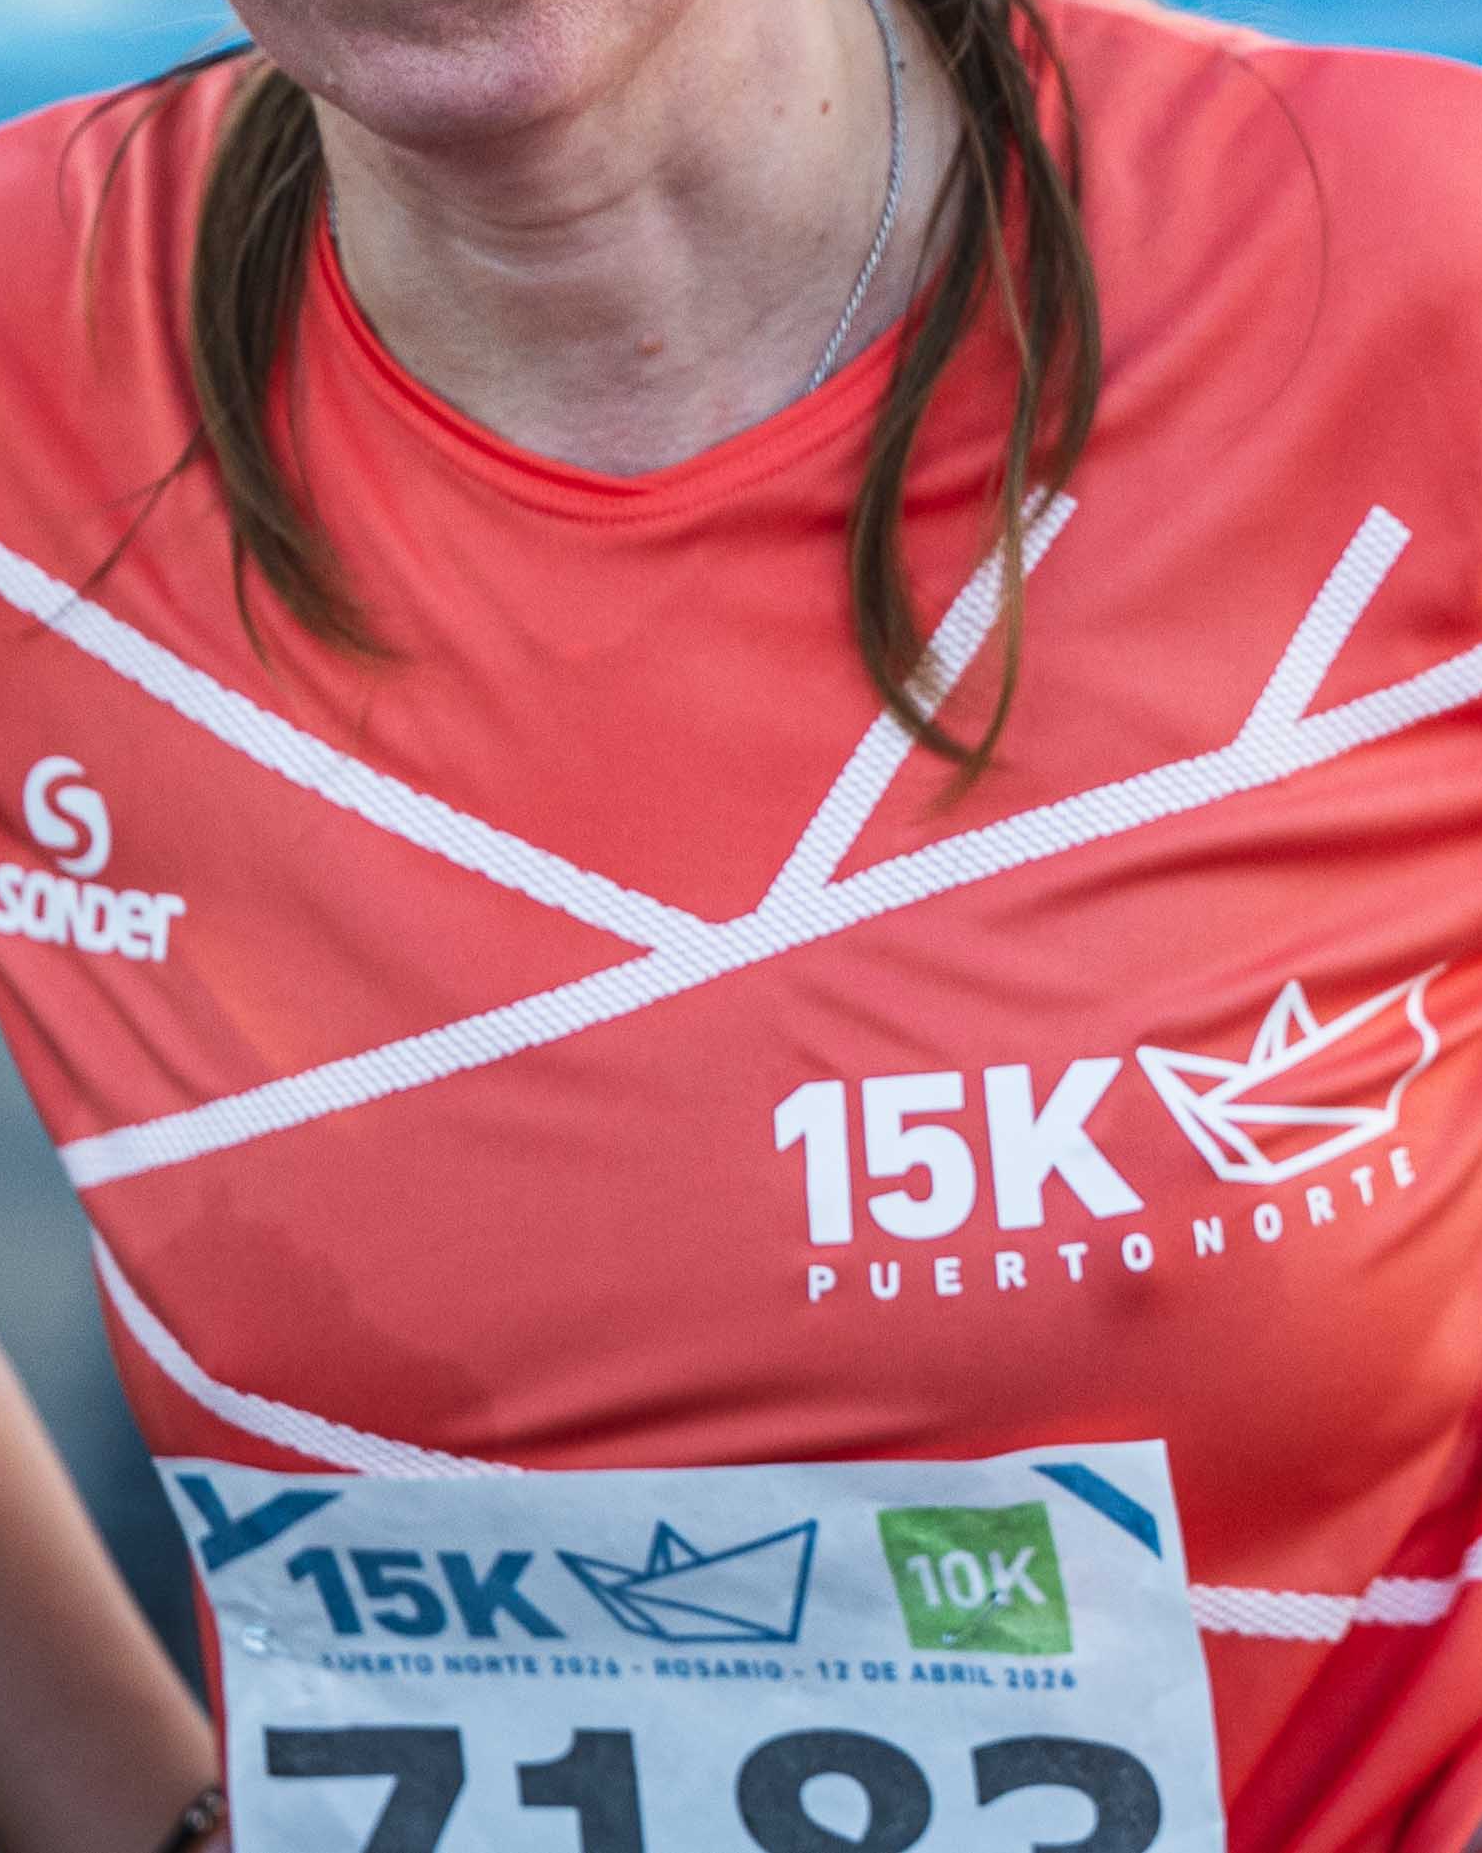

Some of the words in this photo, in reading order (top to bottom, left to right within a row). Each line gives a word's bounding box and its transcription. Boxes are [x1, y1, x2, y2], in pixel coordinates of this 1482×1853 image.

[774, 1056, 1145, 1247] 15K
[808, 1233, 1154, 1303] PUERTO
[1192, 1147, 1416, 1258] NORTE
[285, 1548, 568, 1641] 15K
[905, 1546, 1049, 1610] 10K
[443, 1653, 539, 1677] NORTE
[549, 1654, 622, 1679] 2026
[653, 1656, 785, 1682] ROSARIO
[861, 1660, 899, 1683] DE
[910, 1662, 996, 1688] ABRIL
[1003, 1666, 1078, 1691] 2026
